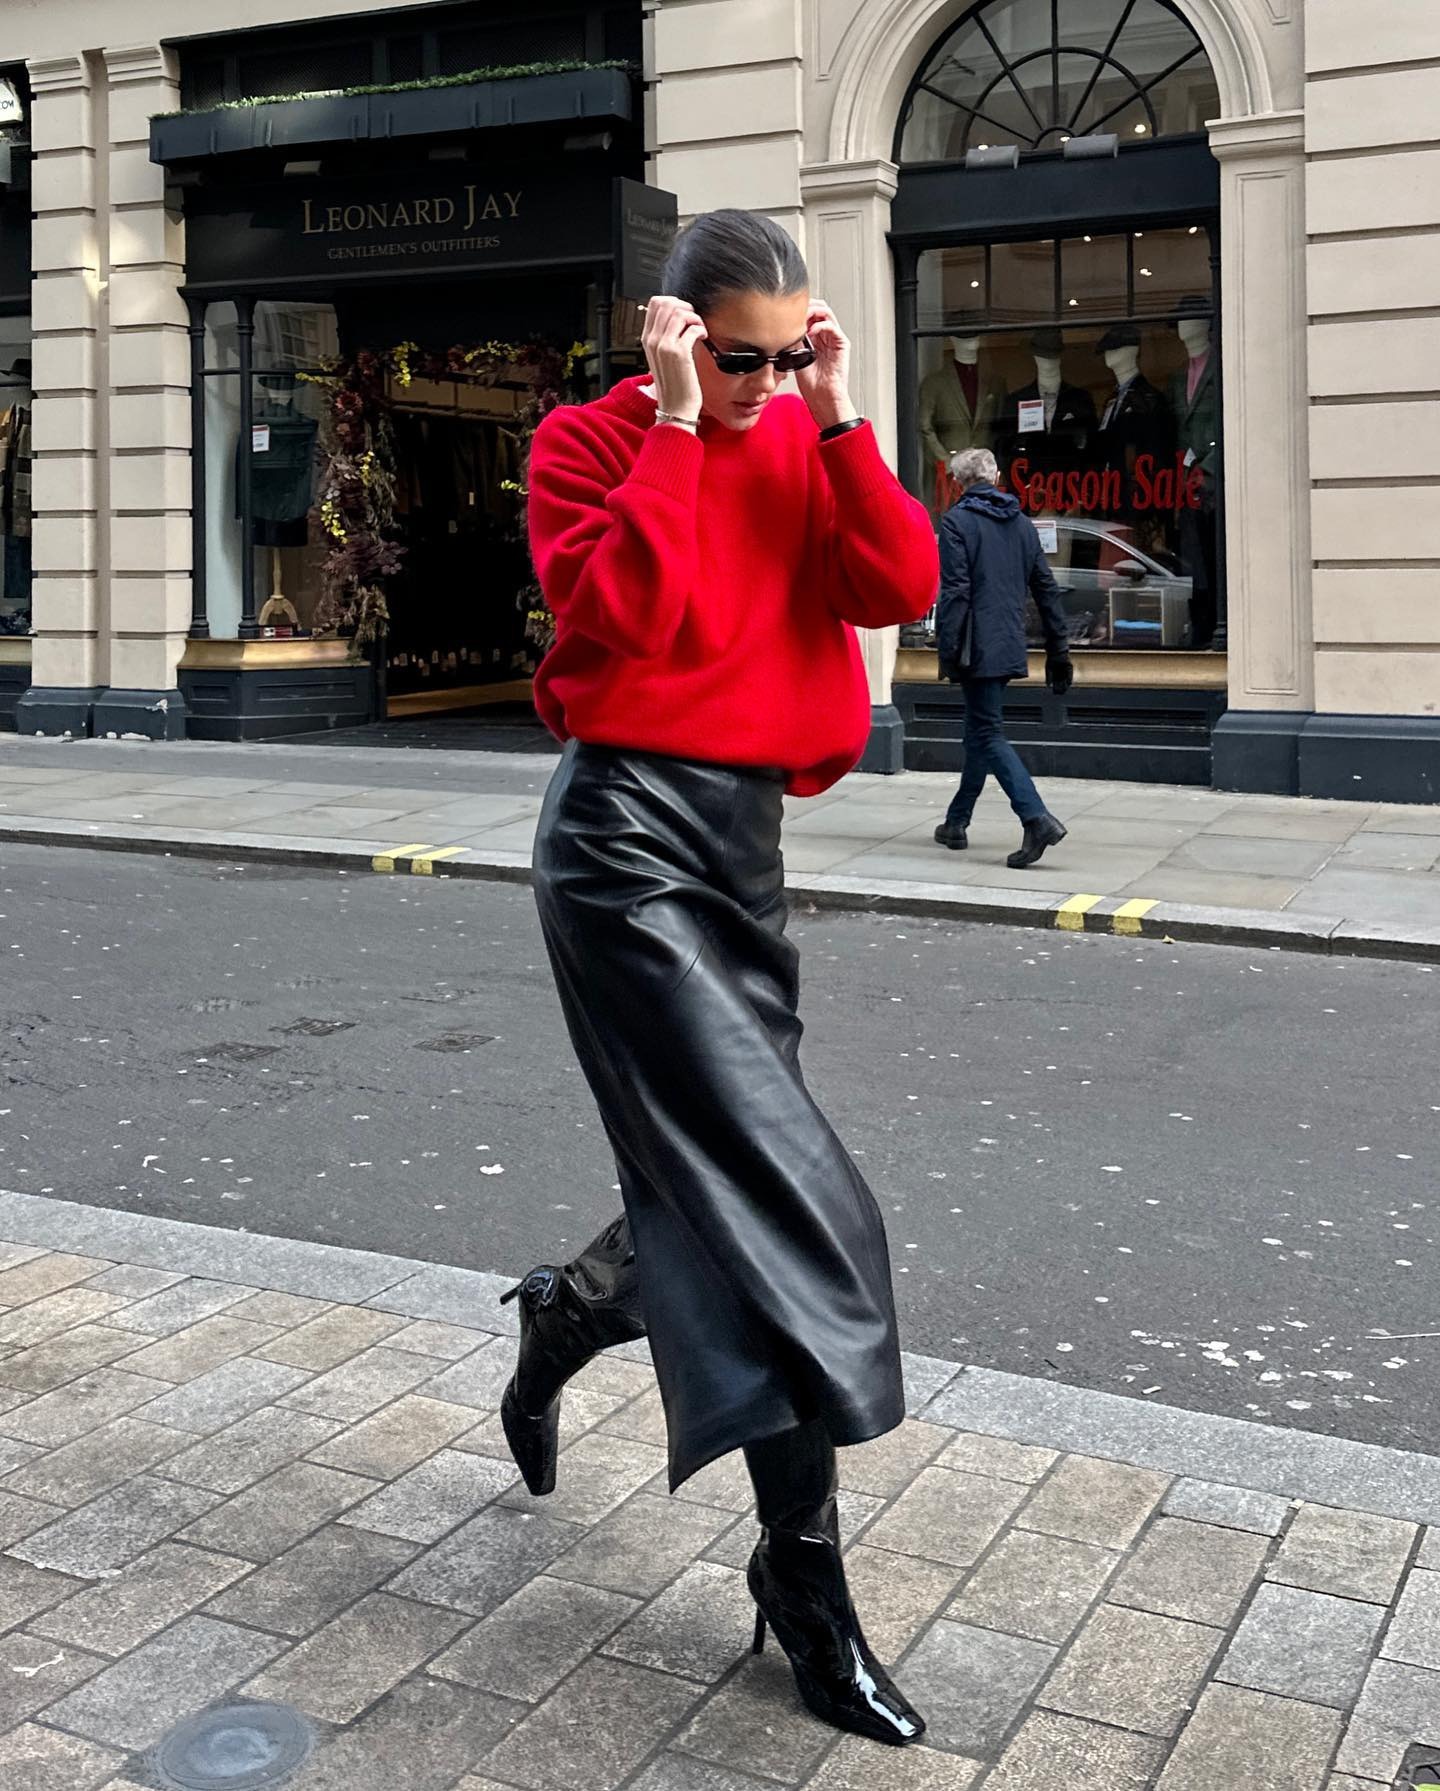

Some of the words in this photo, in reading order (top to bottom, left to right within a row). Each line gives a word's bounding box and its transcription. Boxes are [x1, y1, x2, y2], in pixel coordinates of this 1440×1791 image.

[301, 197, 455, 234] LEONARD
[463, 184, 523, 231] JAY
[327, 240, 418, 260] GENTLEMEN'S
[420, 235, 501, 254] OUTFITTERS
[1131, 448, 1206, 511] Sale
